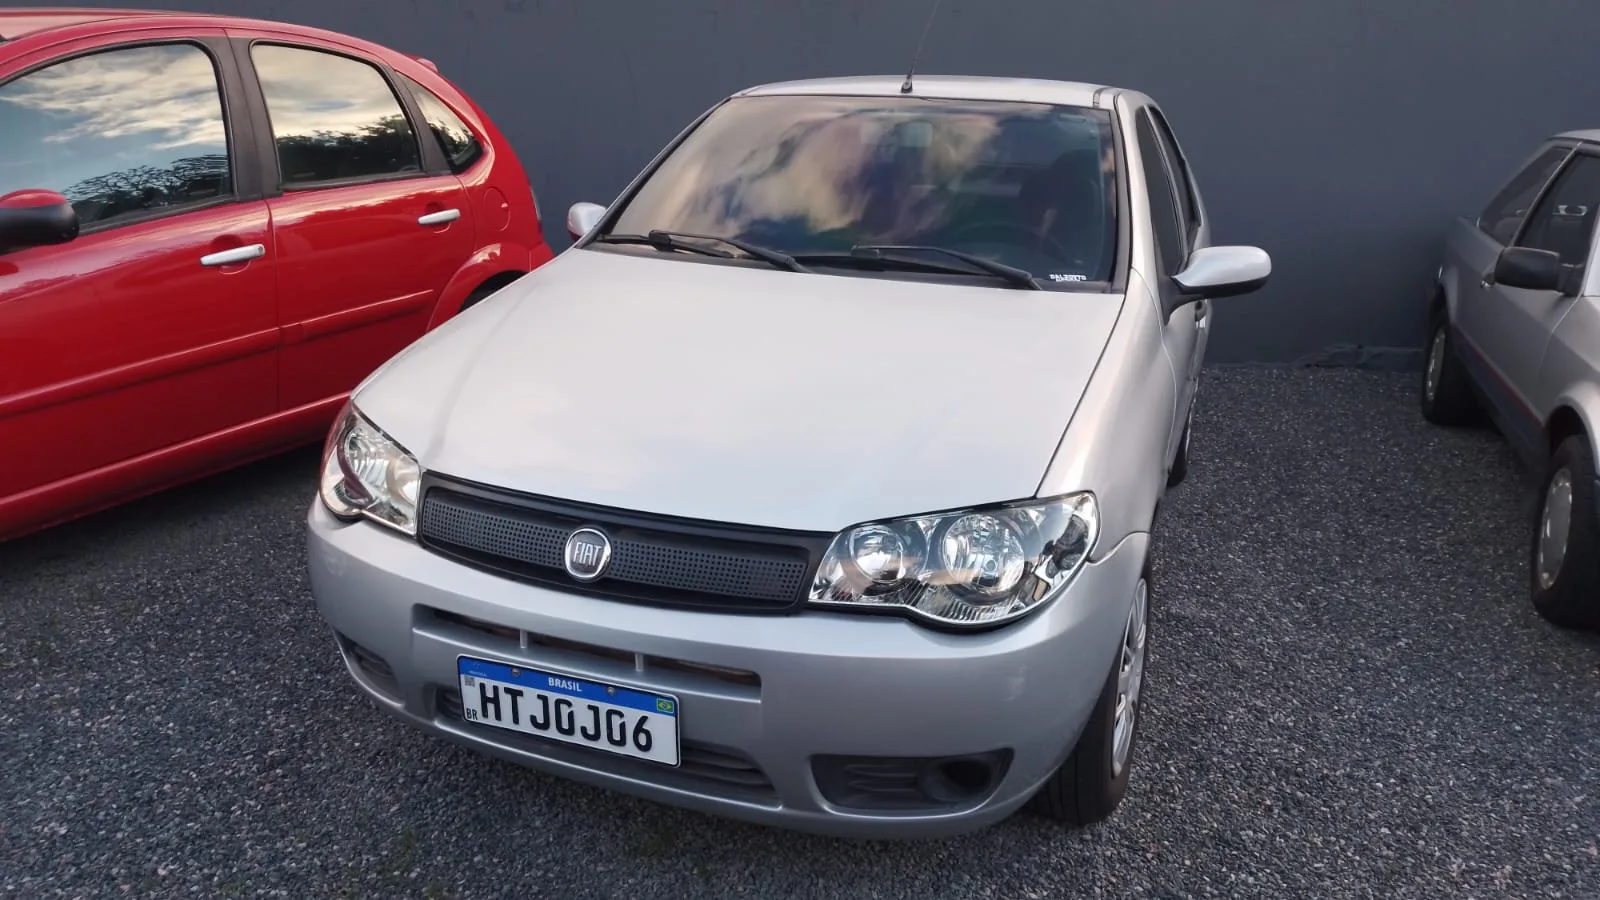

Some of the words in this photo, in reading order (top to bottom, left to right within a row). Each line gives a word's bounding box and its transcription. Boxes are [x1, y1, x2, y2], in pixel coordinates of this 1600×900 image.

[572, 541, 602, 566] FIAT
[548, 677, 583, 692] BRASIL
[466, 707, 478, 721] BR
[479, 682, 653, 752] HTJ0J06
